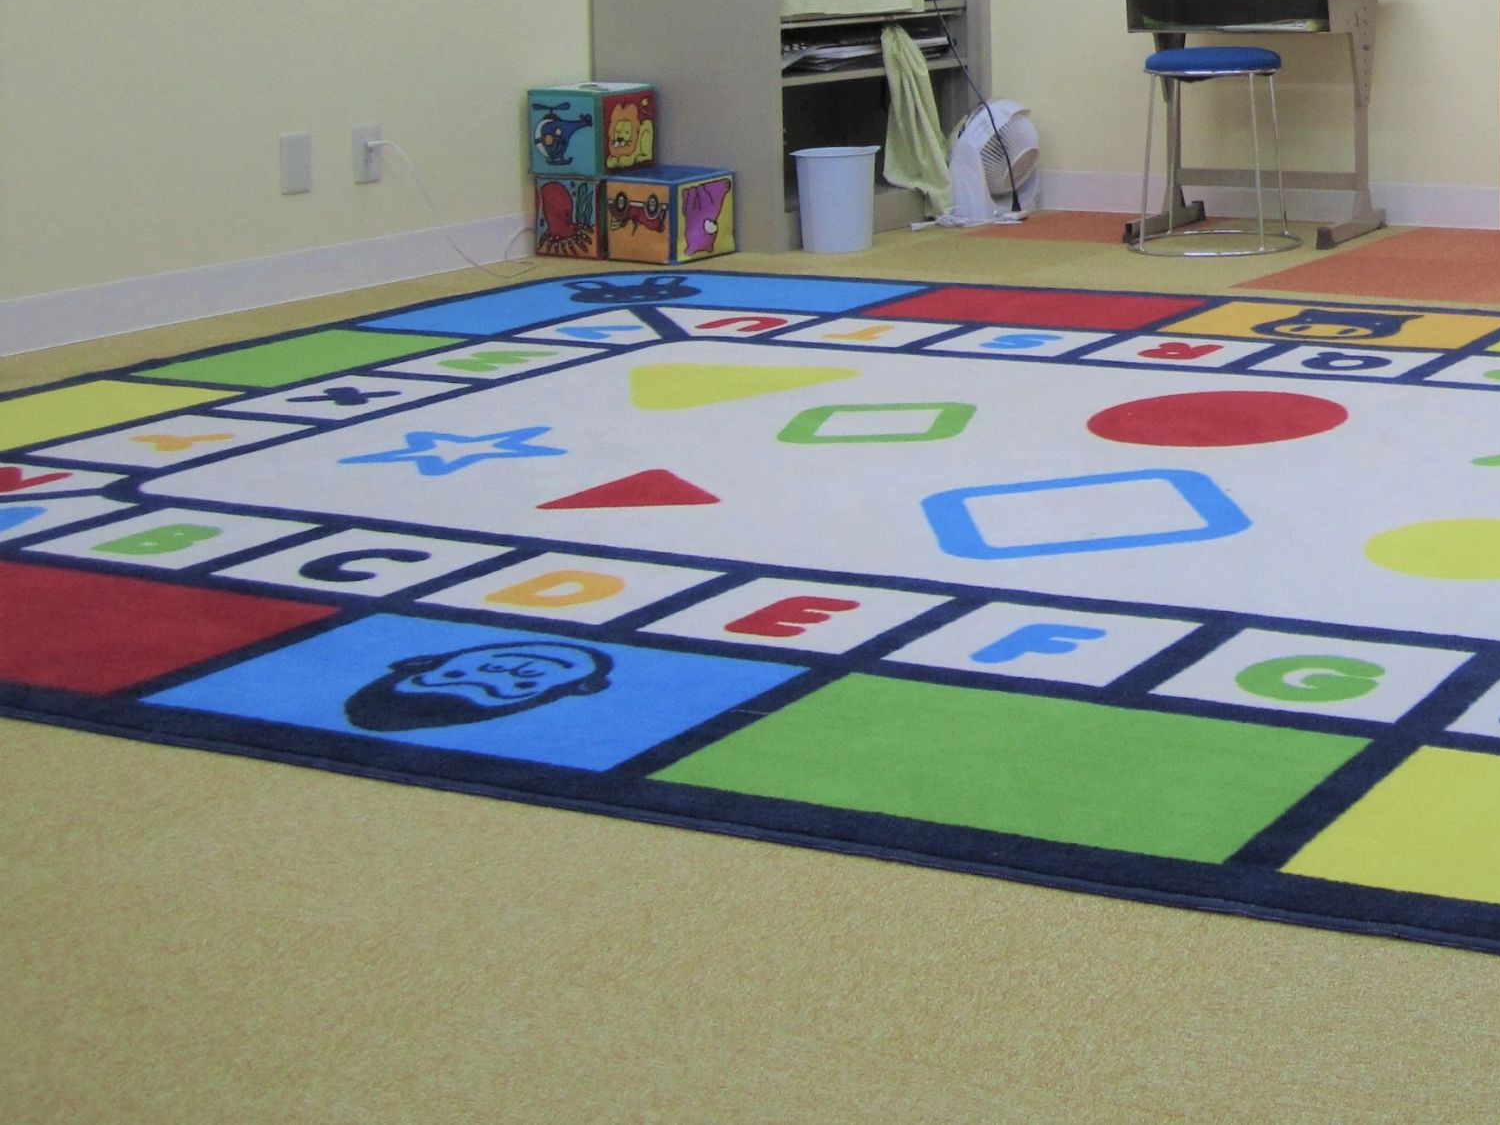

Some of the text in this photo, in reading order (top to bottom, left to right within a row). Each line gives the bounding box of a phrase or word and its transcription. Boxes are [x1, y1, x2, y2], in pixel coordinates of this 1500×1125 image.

[695, 316, 788, 332] U
[827, 326, 890, 341] T
[980, 334, 1061, 349] S
[1138, 342, 1224, 360] R
[1301, 352, 1392, 371] Q
[286, 387, 402, 406] X
[92, 524, 219, 555] B
[298, 548, 432, 583] C
[485, 571, 623, 609] D
[724, 596, 861, 638] E
[970, 623, 1106, 664] F
[1235, 656, 1385, 704] G
